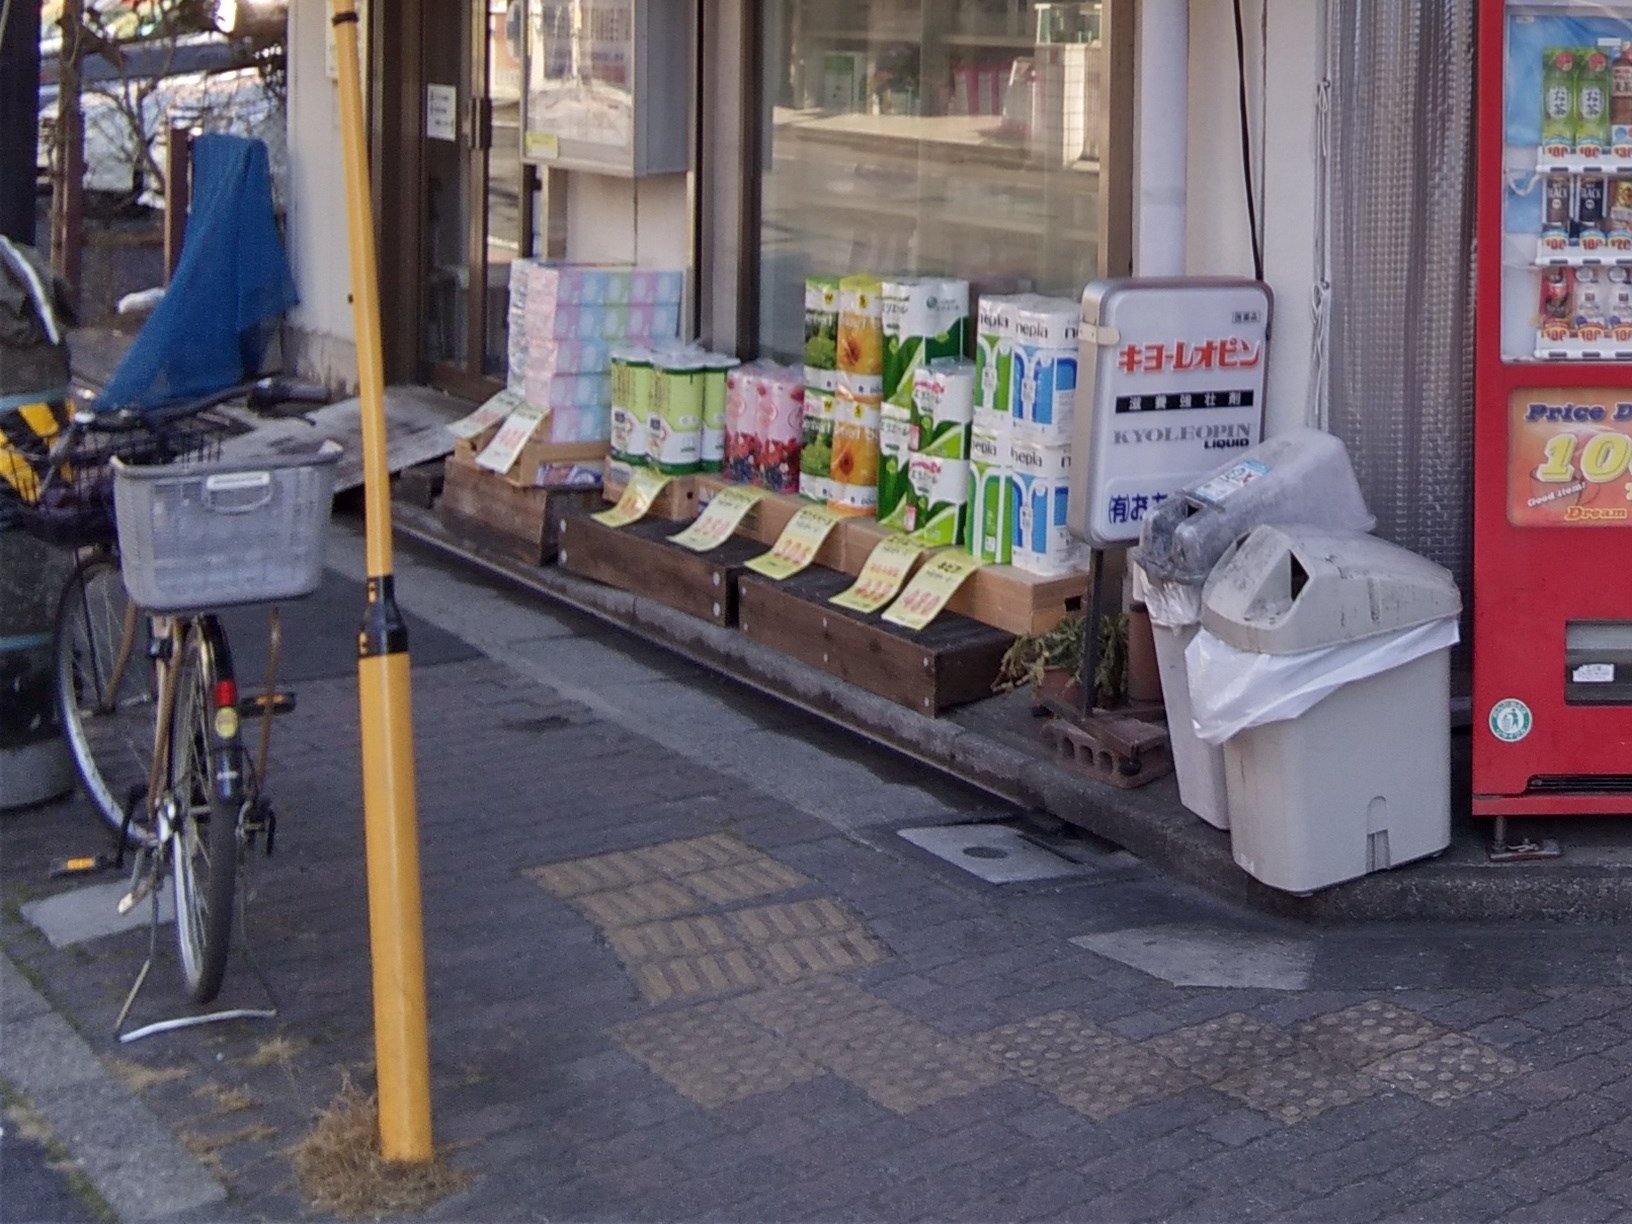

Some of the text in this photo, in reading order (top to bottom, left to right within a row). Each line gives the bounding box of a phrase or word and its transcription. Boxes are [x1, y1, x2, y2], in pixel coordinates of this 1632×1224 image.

[1525, 403, 1606, 423] Price
[1113, 423, 1250, 444] KYOLEOPIN
[1203, 438, 1249, 450] LIQUID
[1527, 491, 1556, 508] Good
[1564, 505, 1628, 521] Dream
